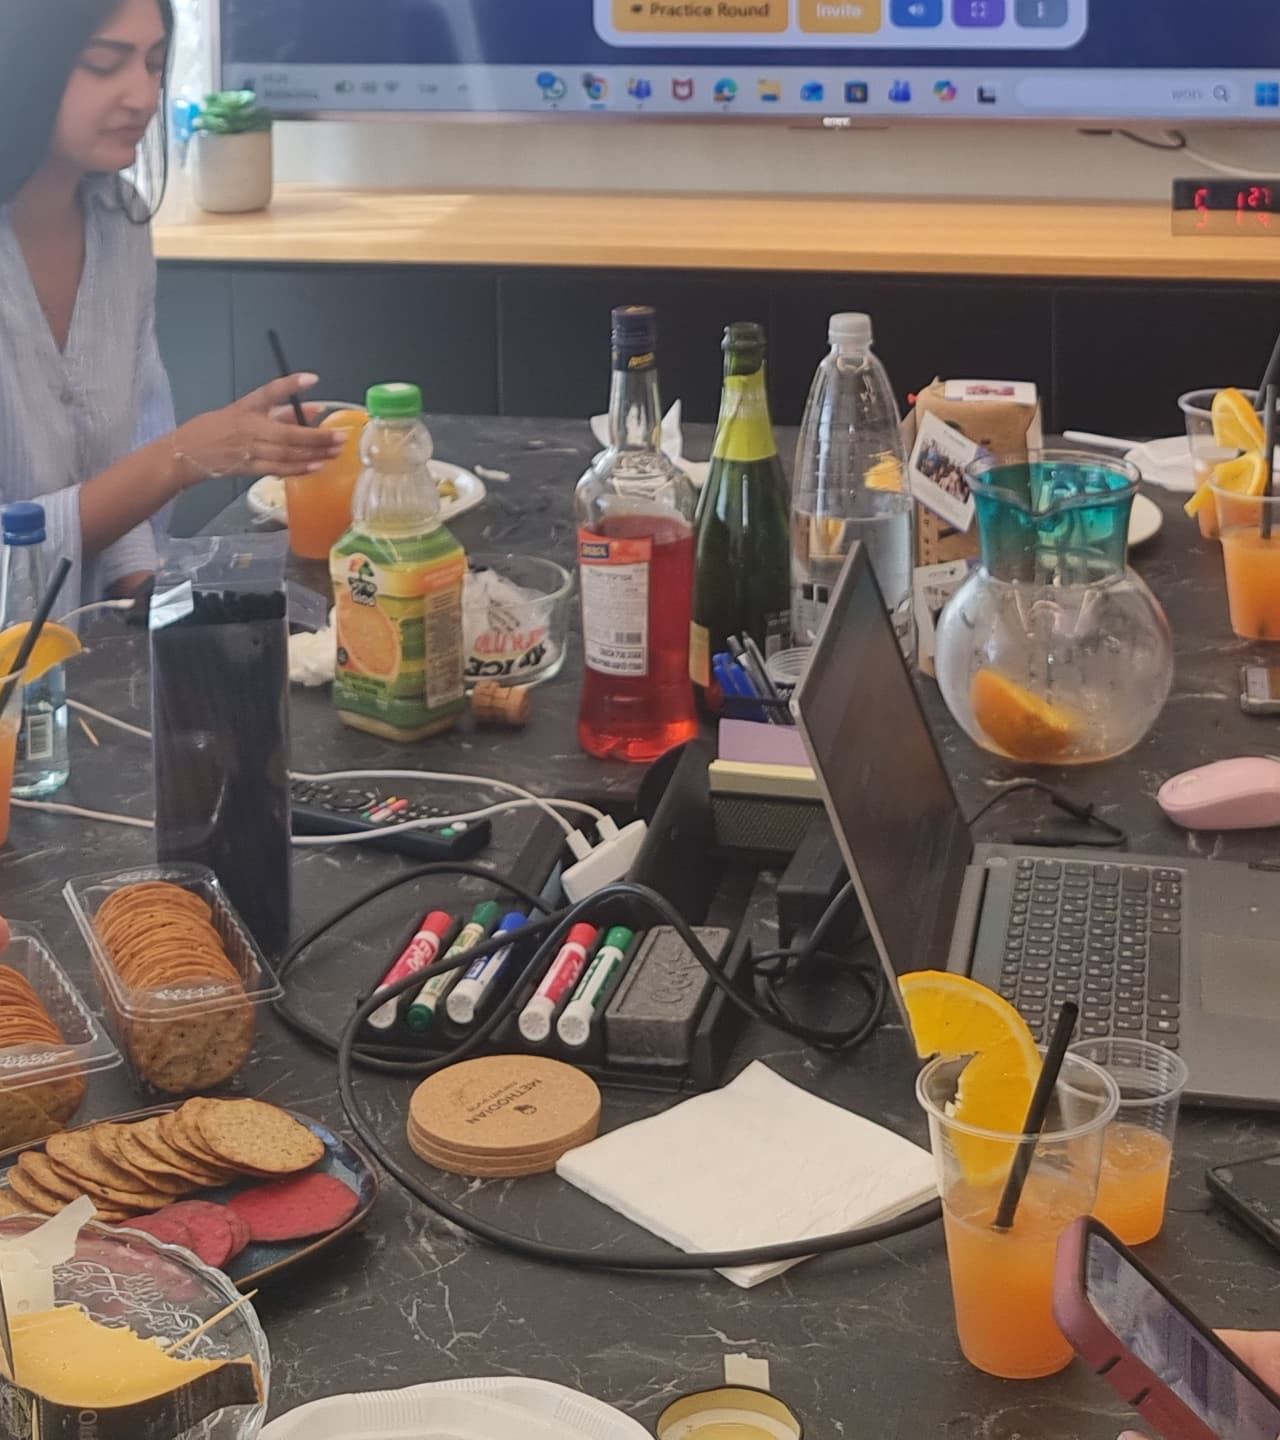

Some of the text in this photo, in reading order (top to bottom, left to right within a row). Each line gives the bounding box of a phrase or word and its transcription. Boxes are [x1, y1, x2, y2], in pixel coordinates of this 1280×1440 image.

[650, 0, 769, 20] Practice Round
[817, 2, 863, 21] Invite
[465, 1077, 543, 1124] METHODIAN
